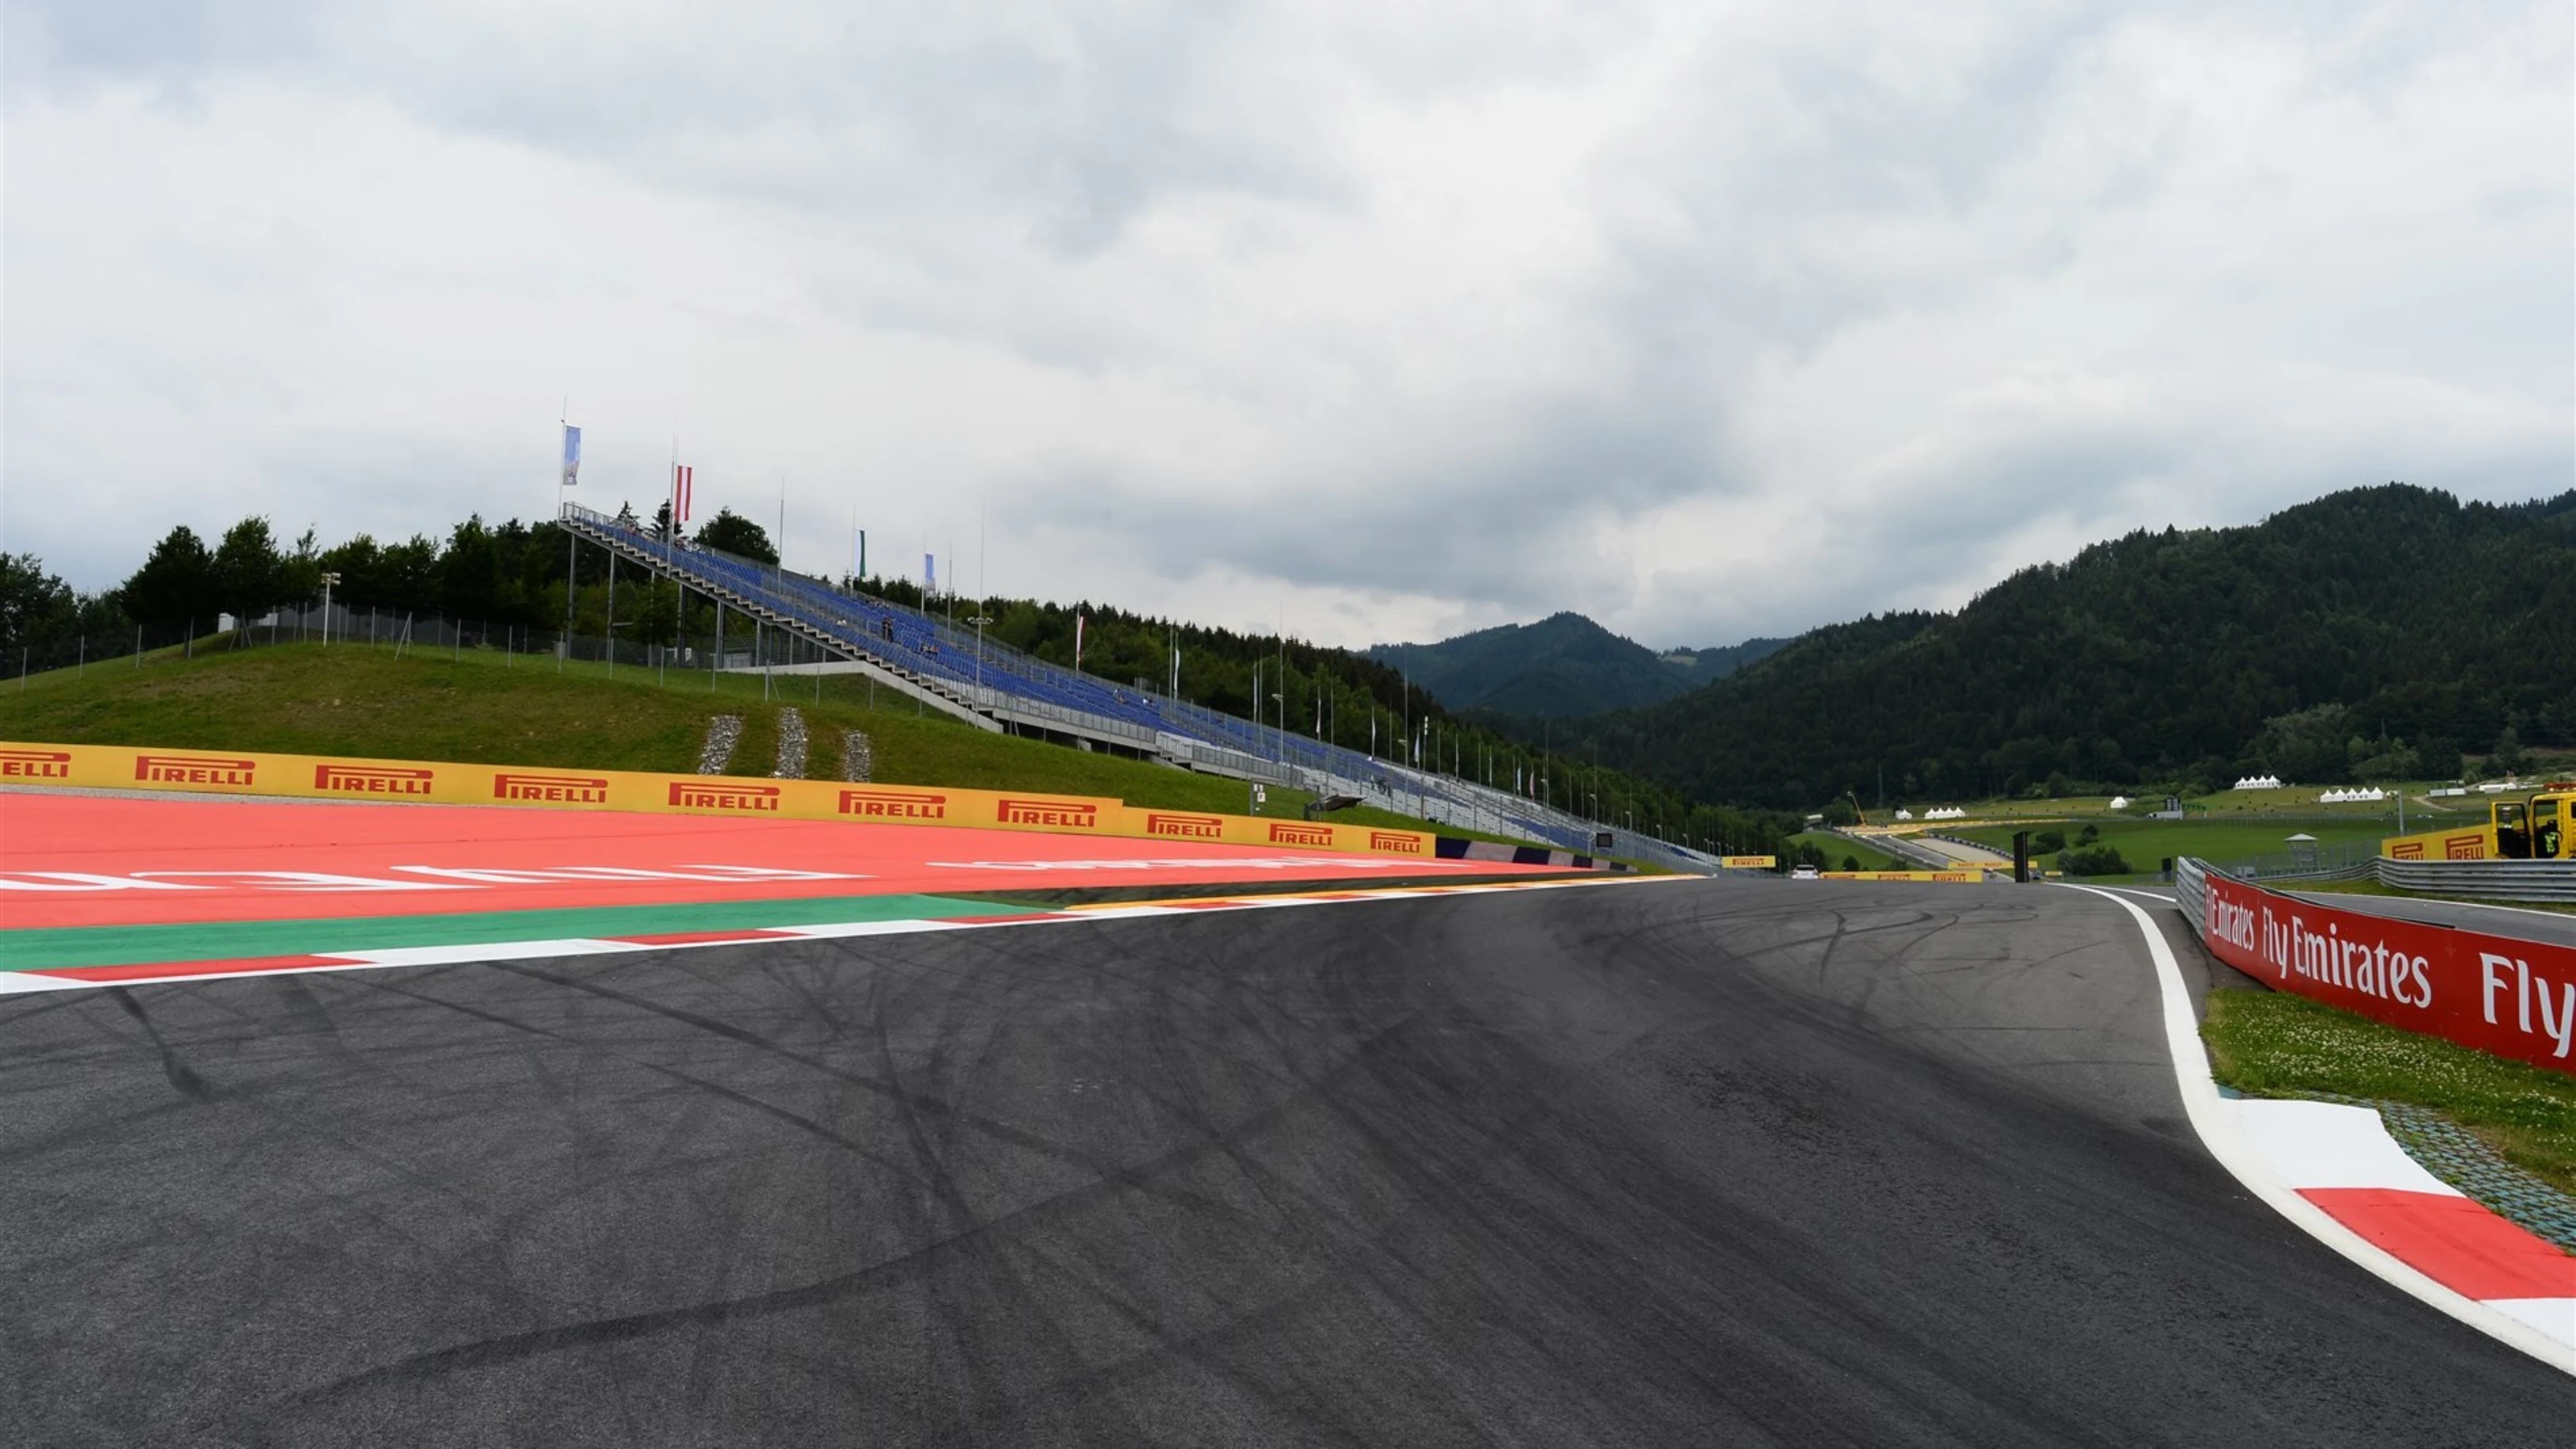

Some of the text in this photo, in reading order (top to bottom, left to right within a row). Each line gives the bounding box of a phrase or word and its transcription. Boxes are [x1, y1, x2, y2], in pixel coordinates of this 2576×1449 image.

[0, 750, 72, 778] ELLI
[135, 755, 256, 786] PIRELLI
[314, 764, 434, 795] PIRELLI
[494, 774, 609, 803] PIRELLI
[668, 782, 780, 811] PIRELLI
[838, 790, 947, 819] PIRELLI
[997, 799, 1098, 828] PIRELLI
[1147, 813, 1223, 839] PIRELLI
[1268, 823, 1333, 847] PIRELLI
[1371, 832, 1421, 853] PIRELLI
[2445, 834, 2484, 861] PIRELLI
[2212, 889, 2255, 952] Emirates
[2263, 906, 2433, 1009] Fly Emirates
[2479, 952, 2576, 1059] Fly
